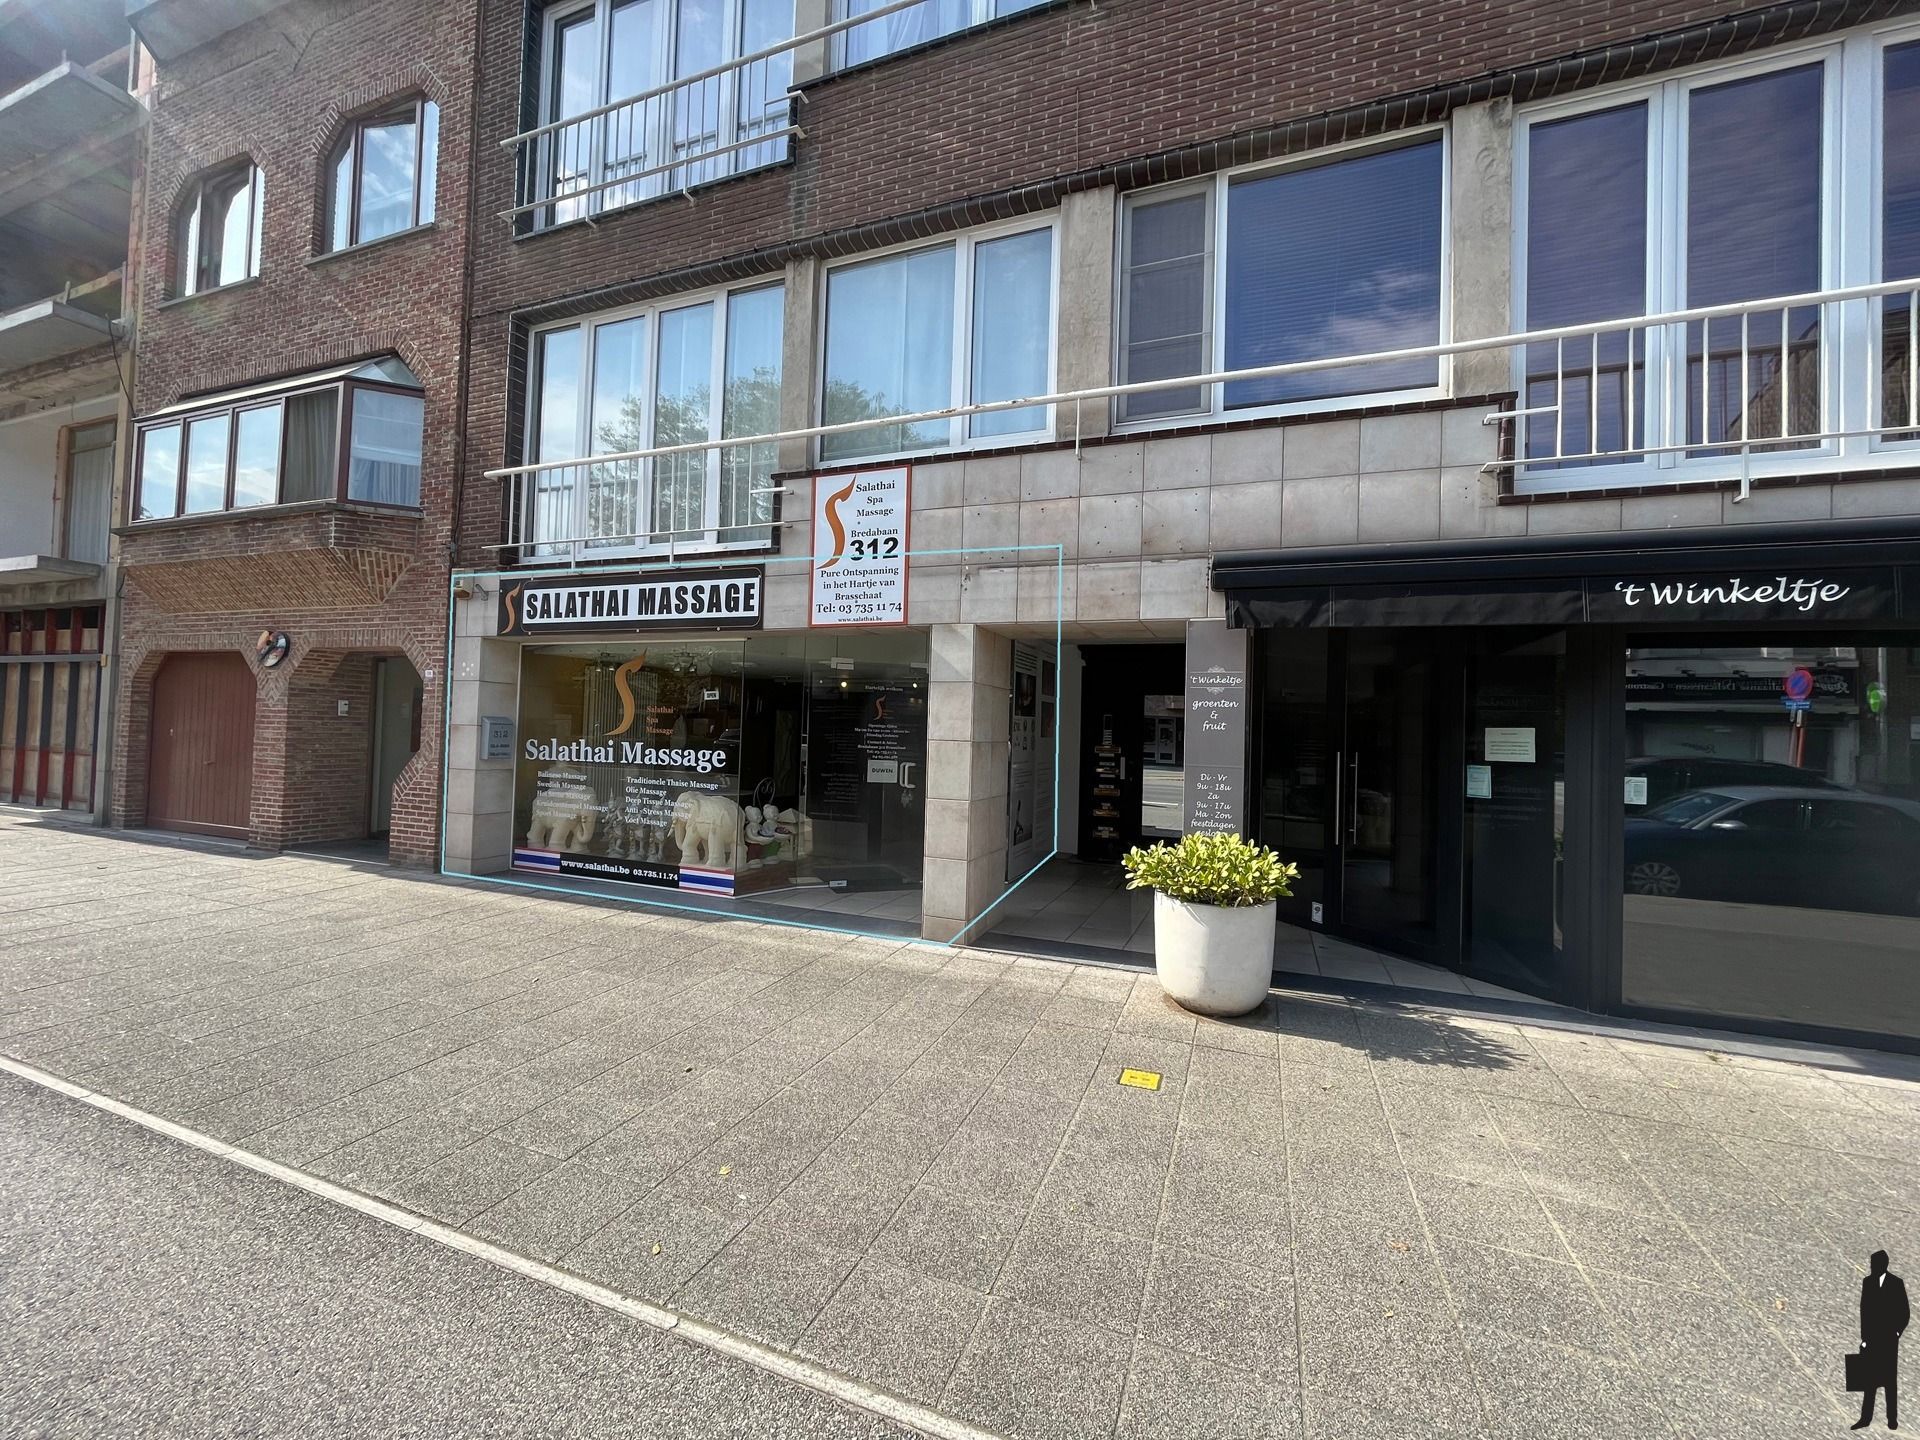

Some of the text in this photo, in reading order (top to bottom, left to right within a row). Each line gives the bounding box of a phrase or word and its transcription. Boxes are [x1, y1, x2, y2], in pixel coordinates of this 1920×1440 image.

[856, 480, 895, 492] Salathai
[866, 496, 883, 505] Spa
[856, 508, 894, 517] Massage
[851, 528, 898, 537] Bredabaan
[849, 537, 899, 560] 312
[842, 566, 899, 577] Ontspanning
[849, 579, 877, 588] Hartje
[835, 592, 882, 601] Brasschaat
[1650, 577, 1850, 611] Winkeltje
[526, 582, 755, 619] SALATHAI MASSAGE
[816, 603, 835, 613] Tel:
[838, 604, 852, 614] 03
[854, 603, 873, 613] 735
[889, 602, 902, 612] 74
[1199, 676, 1242, 686] Winkeltje
[1192, 700, 1239, 710] groenten
[1210, 711, 1218, 719] &
[646, 716, 658, 724] Spa
[1203, 720, 1227, 732] fruit
[646, 727, 673, 736] Massage
[525, 738, 726, 773] Salathai Massage
[563, 772, 587, 781] Massage
[562, 782, 586, 791] Massage
[626, 776, 719, 790] Traditionele Thaise Massage
[1197, 782, 1208, 790] 9u
[640, 788, 667, 796] Massage
[625, 796, 641, 805] Deep
[664, 800, 692, 809] Massage
[1196, 801, 1208, 809] 9u
[1215, 802, 1231, 810] 17u
[583, 803, 608, 812] Massage
[664, 810, 692, 819] Massage
[640, 818, 667, 827] Massage
[1191, 819, 1236, 830] feestdagen
[633, 868, 678, 881] 03.735.11.74
